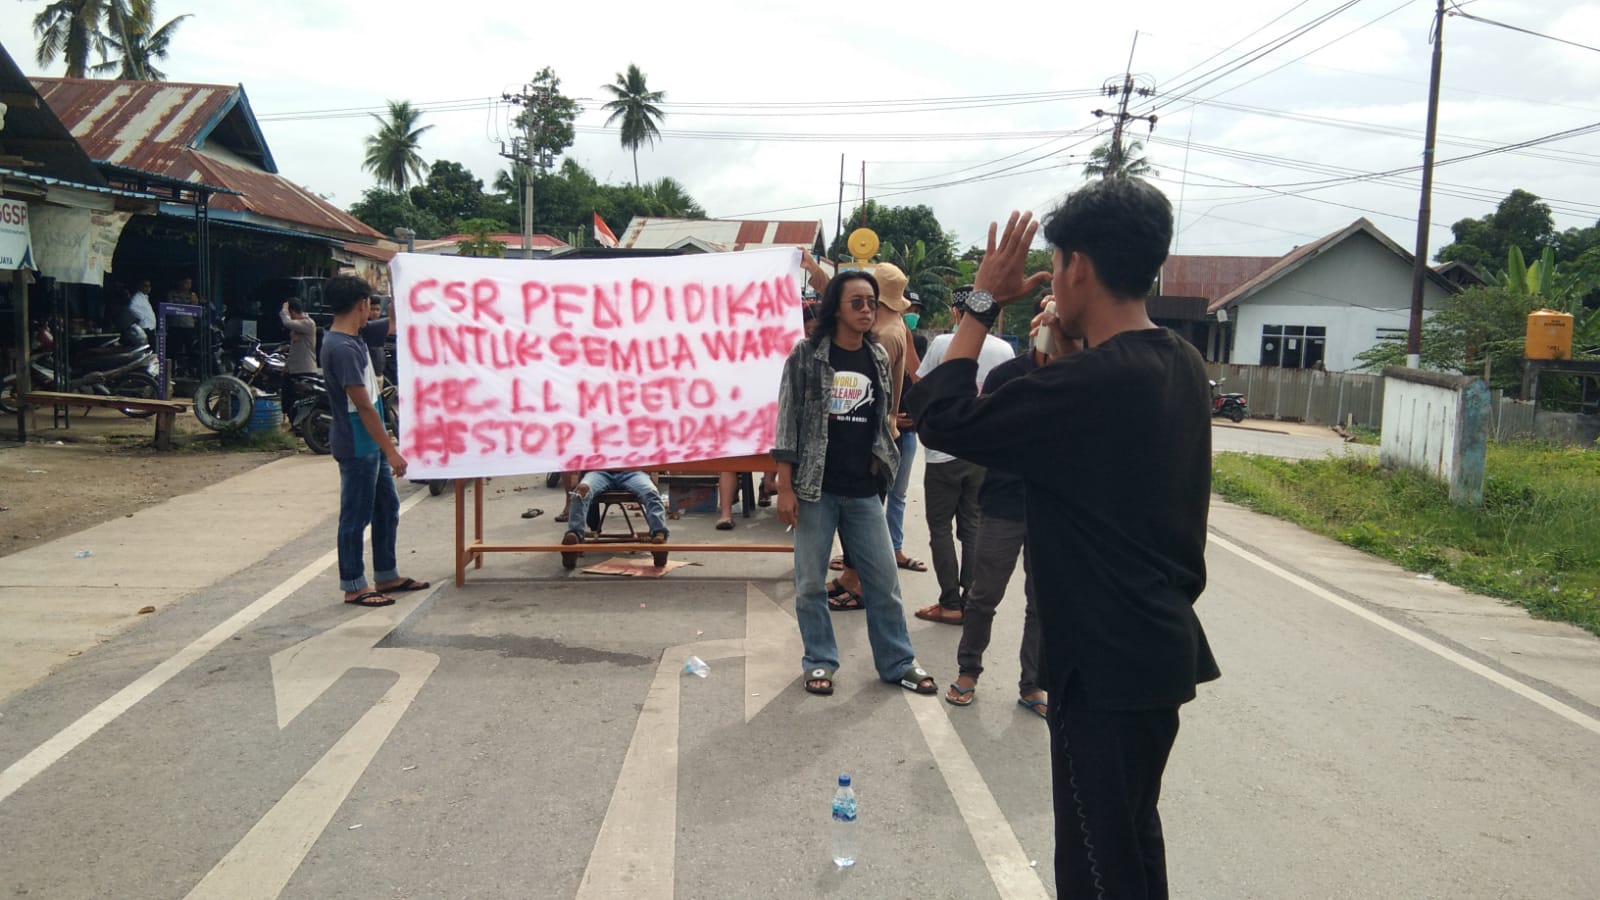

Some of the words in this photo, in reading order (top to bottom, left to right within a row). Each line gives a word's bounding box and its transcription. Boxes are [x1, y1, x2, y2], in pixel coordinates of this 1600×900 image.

[408, 278, 505, 325] CSR
[520, 273, 801, 330] PENDIDIKAN
[407, 323, 543, 370] UNTUK
[548, 331, 697, 376] SEMUA
[511, 378, 562, 414] LL
